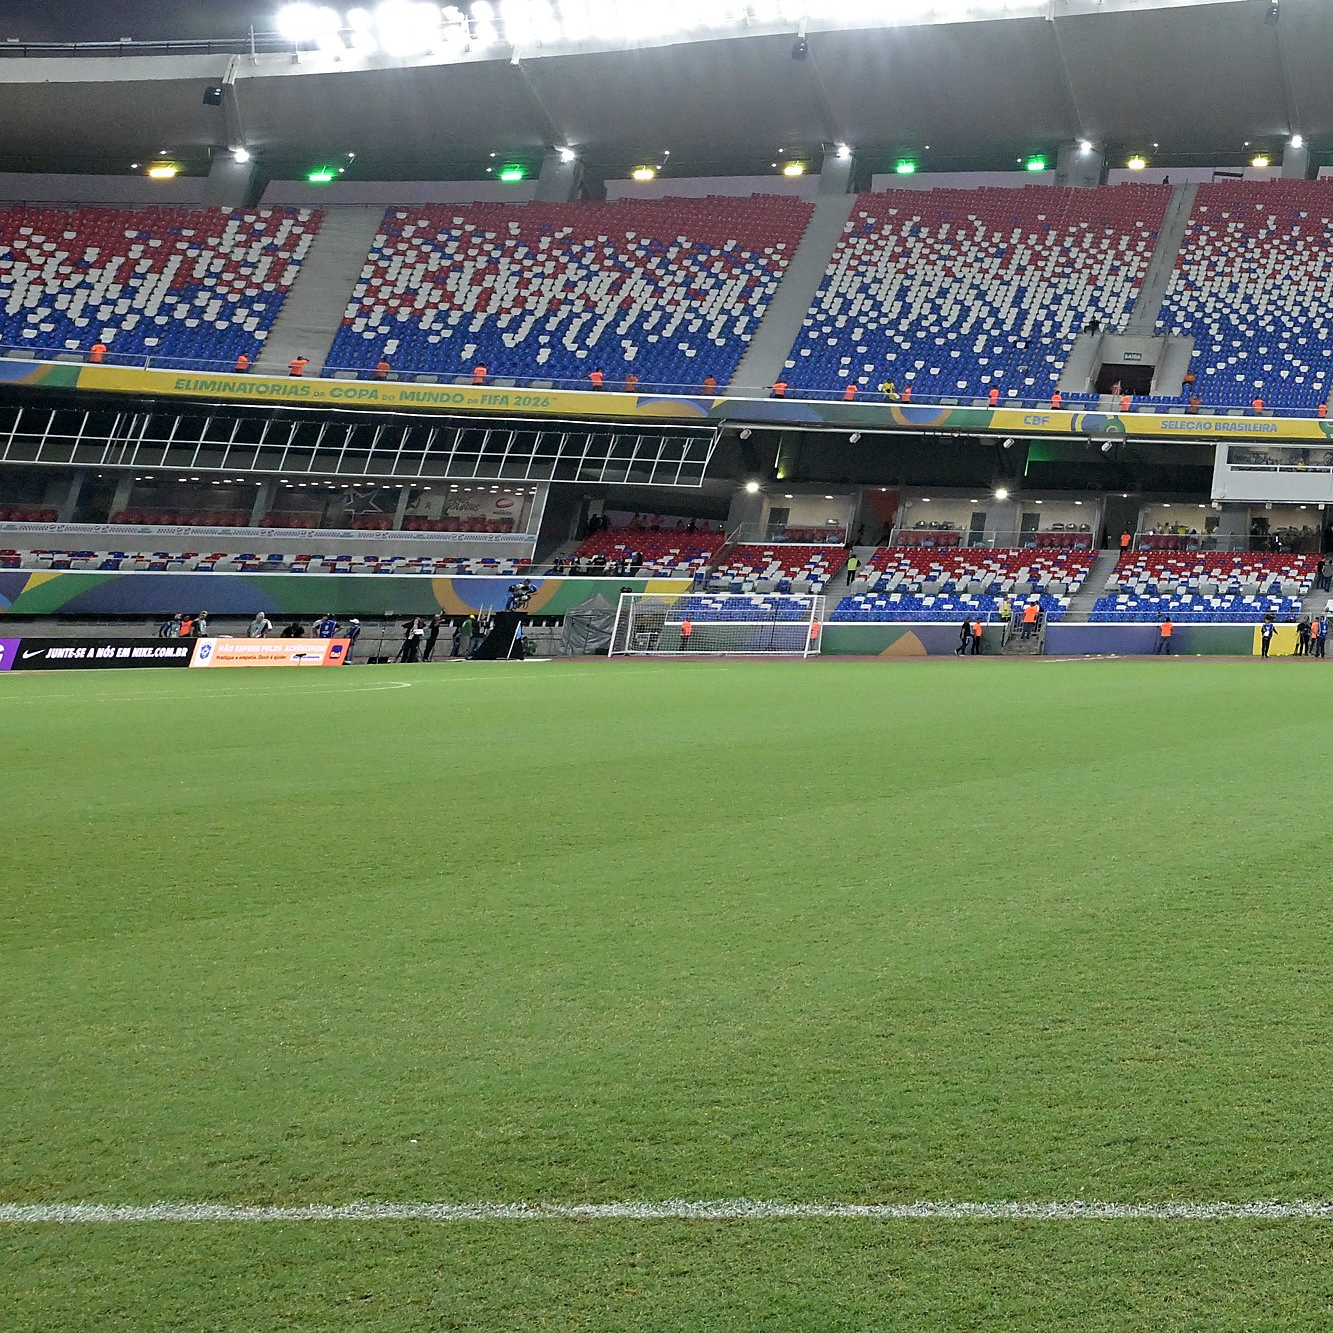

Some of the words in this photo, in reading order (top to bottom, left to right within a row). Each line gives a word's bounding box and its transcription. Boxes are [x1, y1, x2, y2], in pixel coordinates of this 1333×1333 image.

[329, 387, 379, 400] COPA
[399, 390, 464, 404] MUNDO
[480, 394, 509, 406] FIFA
[513, 396, 550, 407] 2026
[1023, 415, 1050, 426] CBF
[1214, 422, 1278, 432] BRASILEIRA
[45, 647, 87, 659] JUNTE-SE
[86, 648, 96, 658] A
[95, 645, 116, 658] NÓS
[116, 647, 131, 658] EM
[131, 647, 189, 657] NIKE.COM.BR
